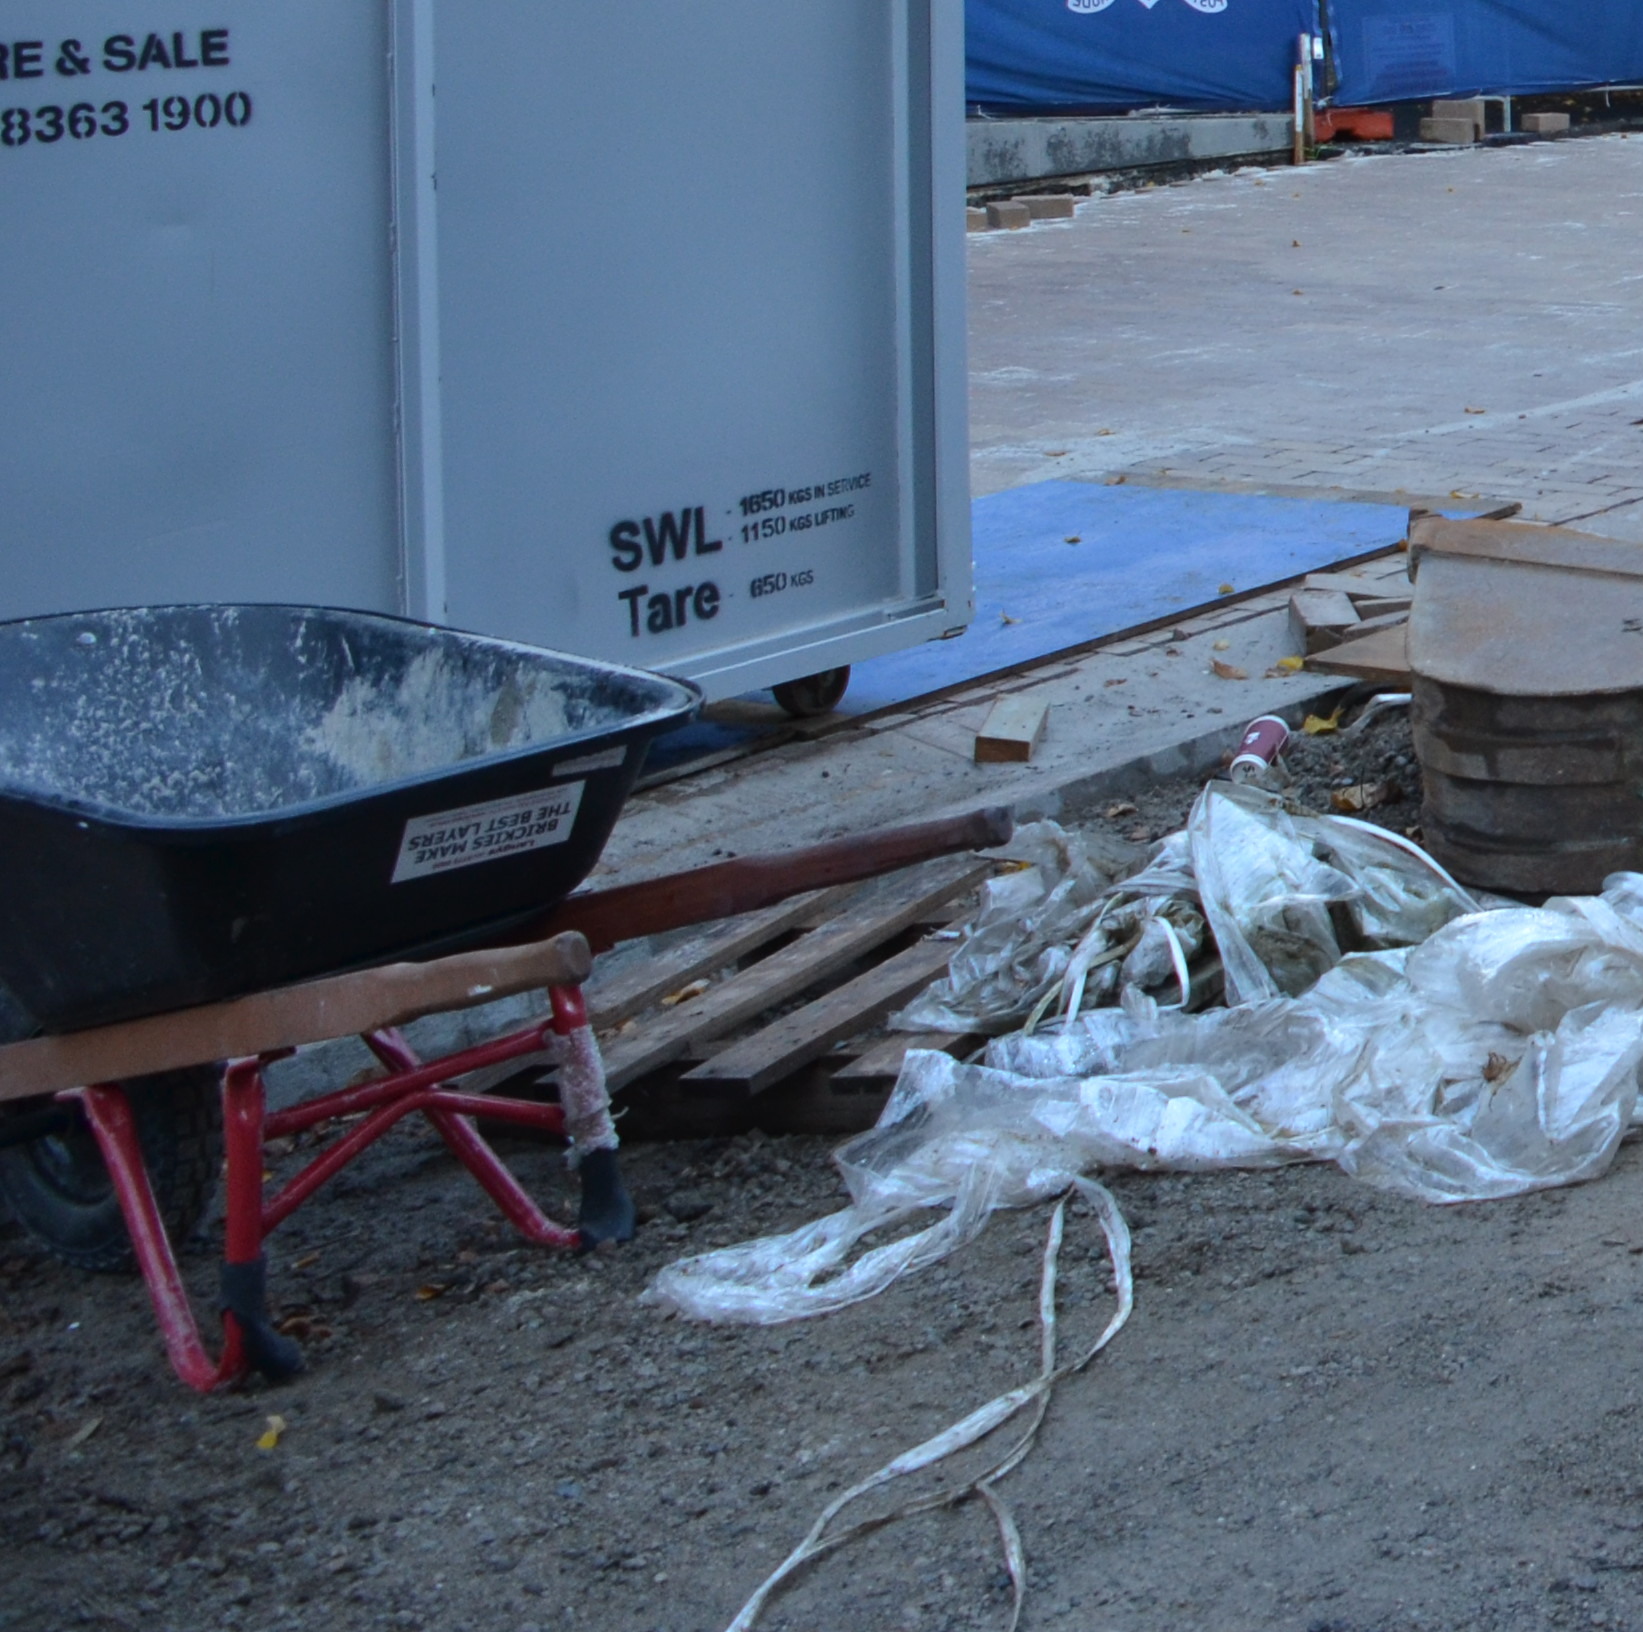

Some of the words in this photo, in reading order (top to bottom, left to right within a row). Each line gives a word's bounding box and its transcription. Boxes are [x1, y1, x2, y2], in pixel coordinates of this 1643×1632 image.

[55, 38, 91, 76] &
[102, 29, 230, 72] SALE
[1, 101, 129, 146] 8363
[142, 91, 252, 133] 1900
[609, 506, 723, 572] SWL
[739, 488, 786, 517] 1650
[788, 487, 812, 505] KGS
[814, 484, 825, 499] IN
[827, 472, 871, 497] SERVICE
[741, 516, 786, 544] 1150
[789, 514, 813, 532] KGS
[814, 504, 855, 527] LIFTING
[618, 579, 720, 638] Tare
[749, 572, 788, 599] 650
[790, 569, 814, 587] KGS
[484, 810, 532, 832] BEST
[537, 802, 571, 817] THE
[408, 821, 481, 851] LAYERS
[472, 818, 559, 850] BRICKIES
[414, 843, 467, 864] MAKE
